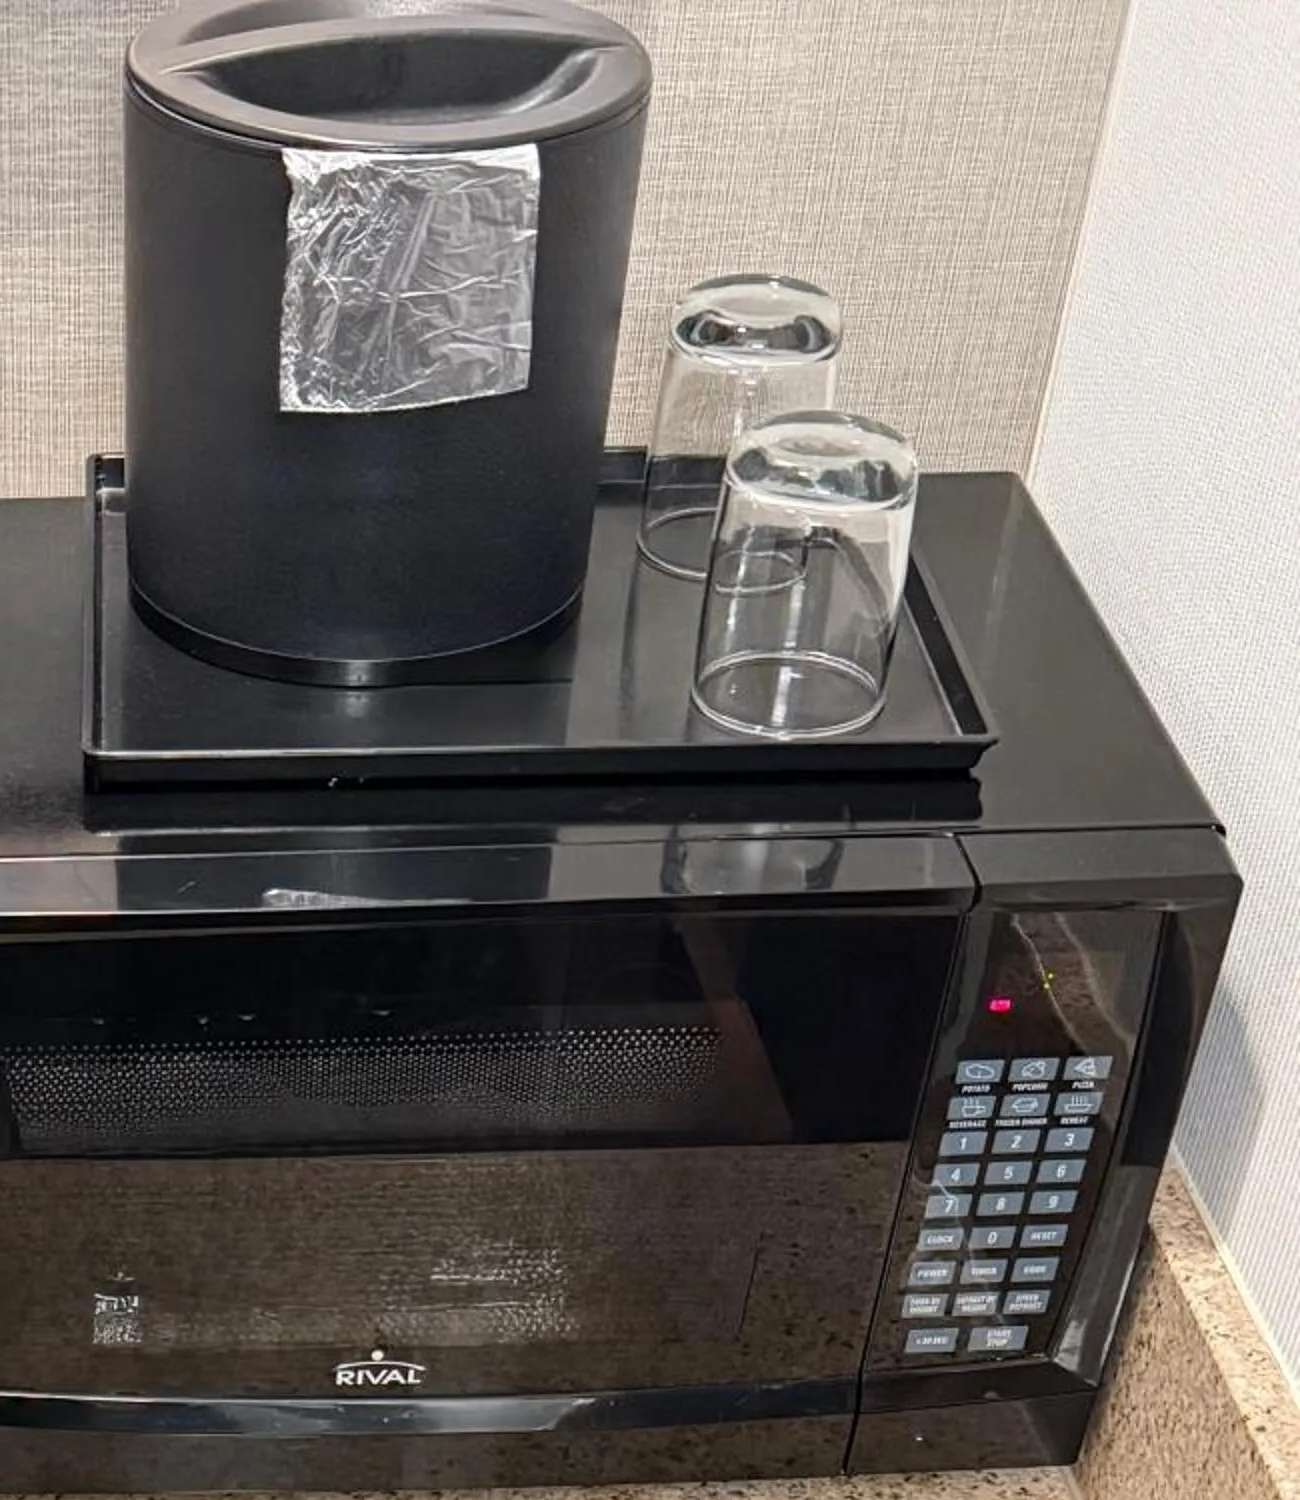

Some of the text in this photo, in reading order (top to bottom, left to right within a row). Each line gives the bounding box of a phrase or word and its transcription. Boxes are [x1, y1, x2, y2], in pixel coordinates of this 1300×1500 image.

[960, 1136, 968, 1150] 1
[1010, 1134, 1023, 1149] 2
[1064, 1132, 1075, 1148] 3
[950, 1167, 961, 1182] 4
[1003, 1165, 1015, 1180] 5
[1056, 1163, 1068, 1179] 6
[945, 1199, 955, 1214] 7
[995, 1196, 1006, 1211] 8
[1048, 1195, 1060, 1209] 9
[987, 1231, 998, 1245] 0
[335, 1369, 422, 1386] RIVAL
